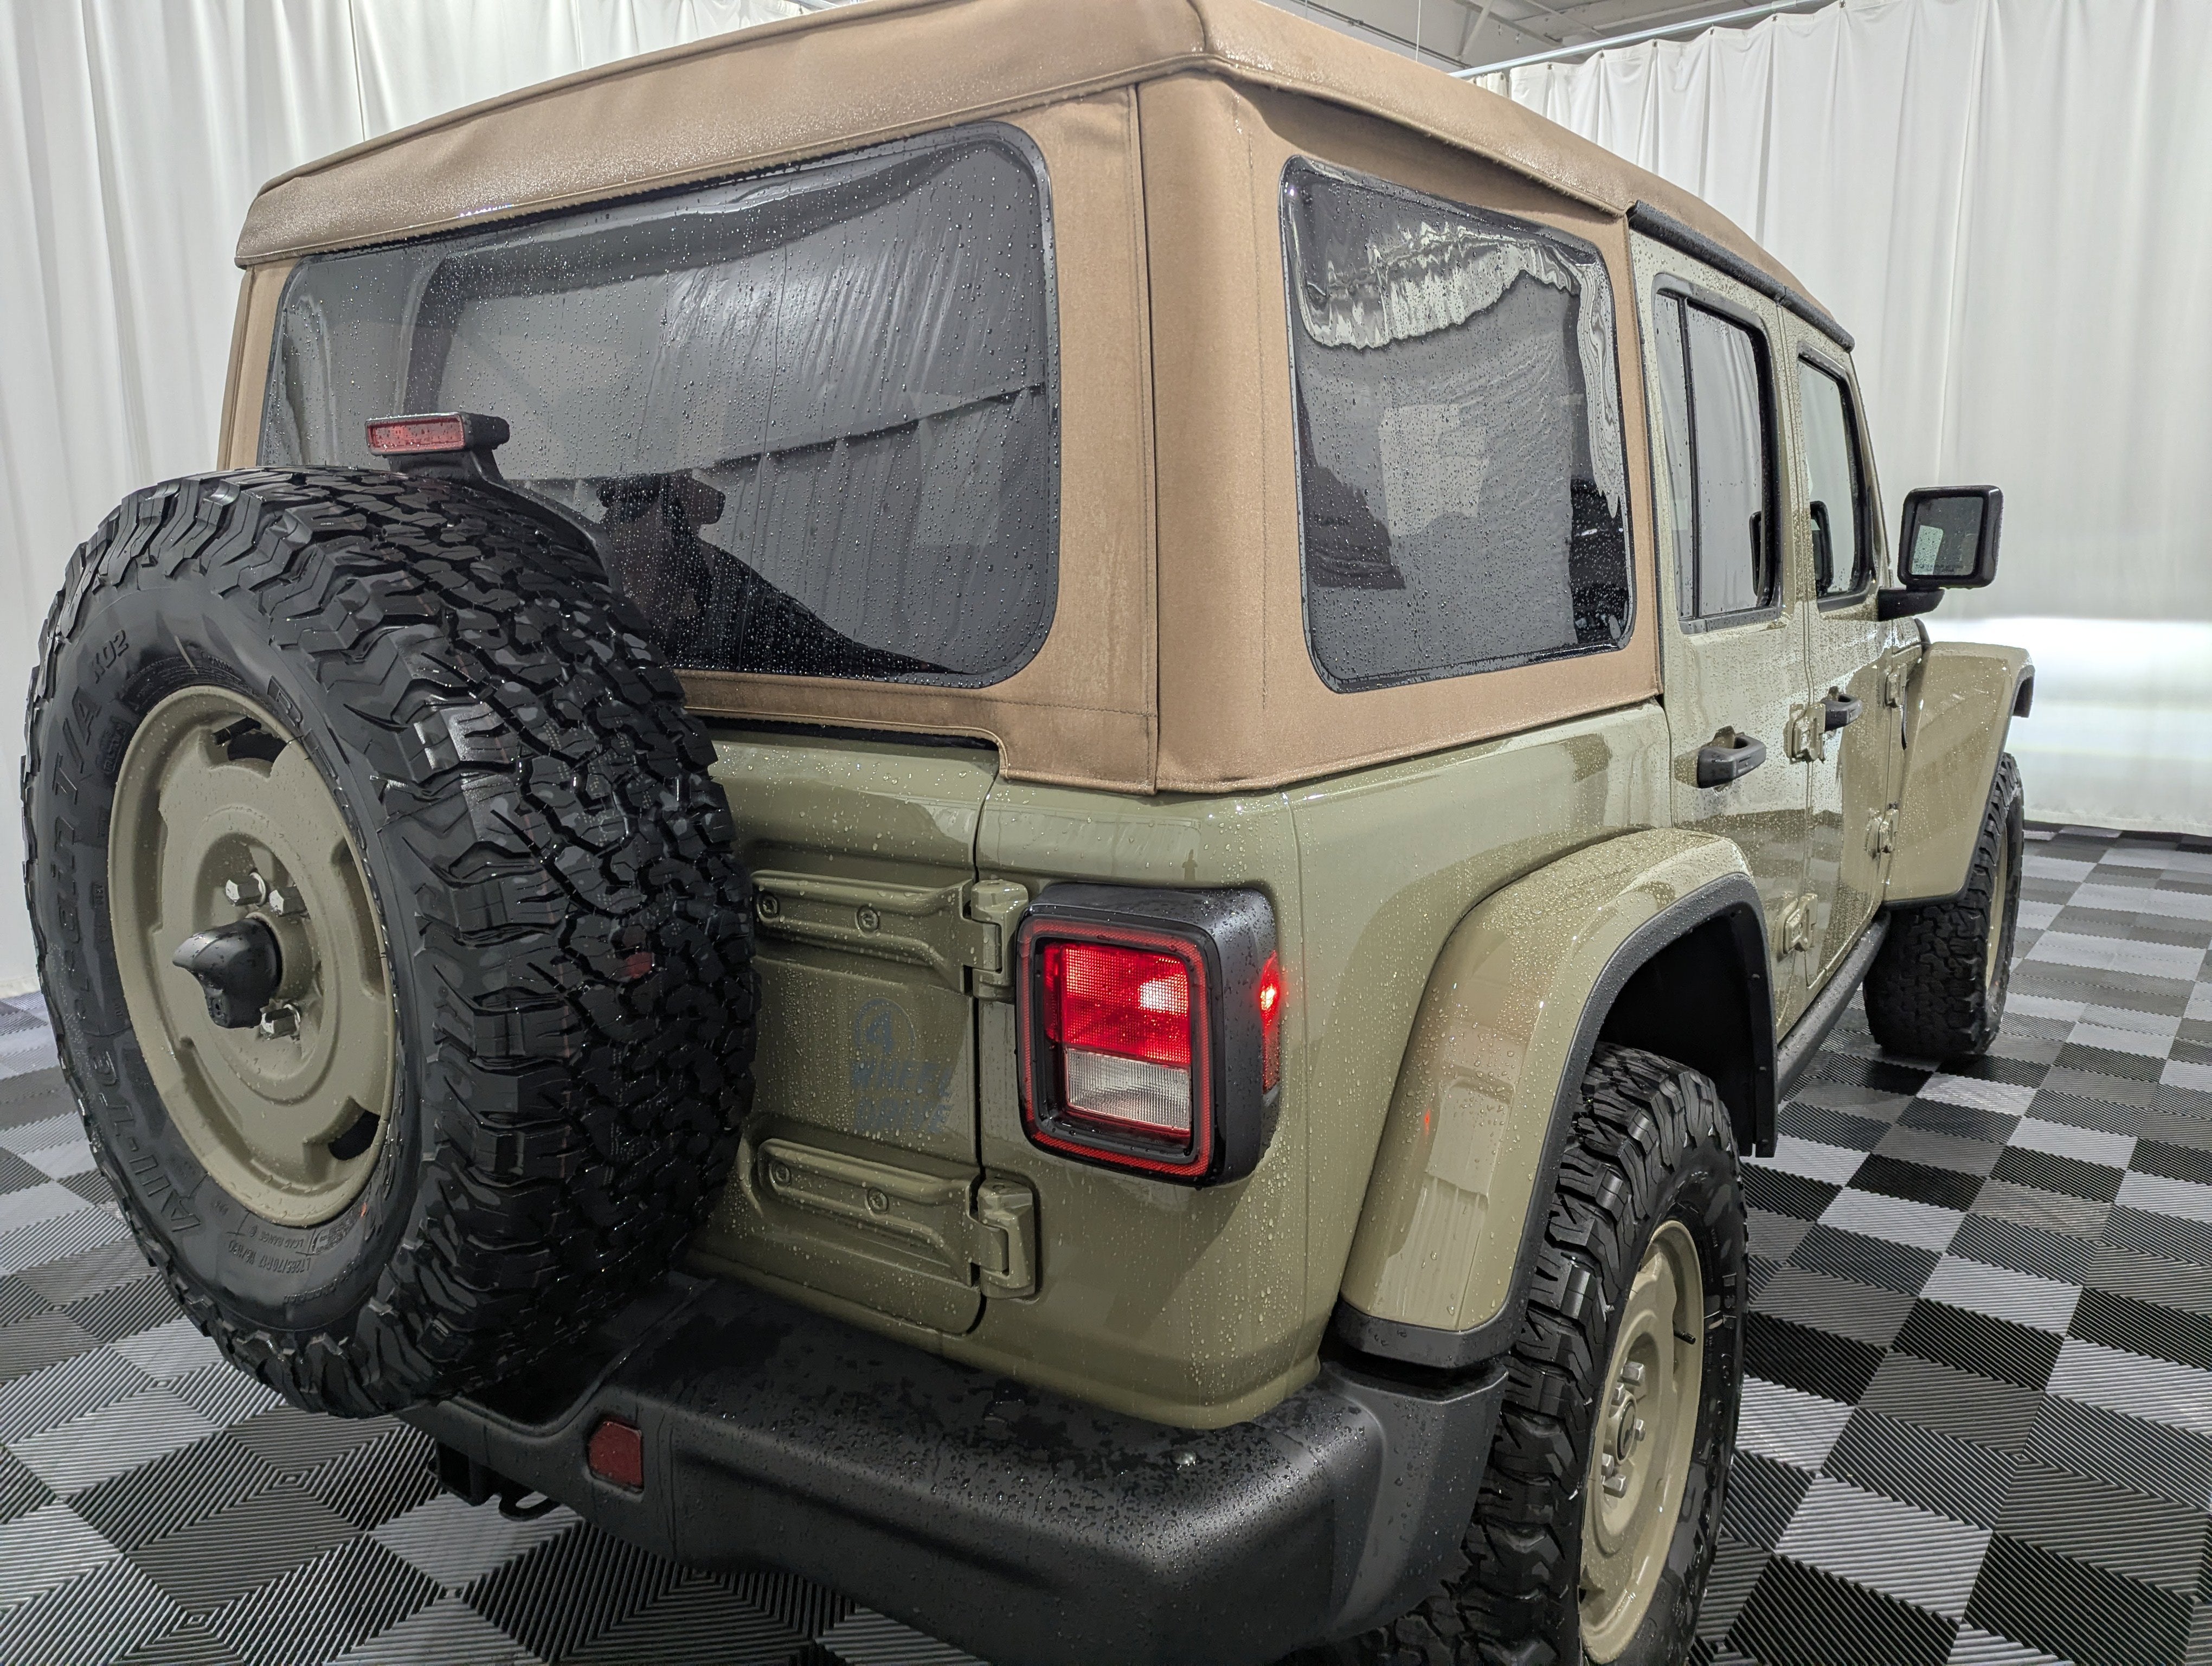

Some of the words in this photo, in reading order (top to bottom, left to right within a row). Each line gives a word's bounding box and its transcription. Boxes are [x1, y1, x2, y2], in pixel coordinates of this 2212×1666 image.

[865, 1010, 894, 1055] 4
[851, 1058, 954, 1097] WHEEL
[854, 1096, 955, 1134] DRIVE
